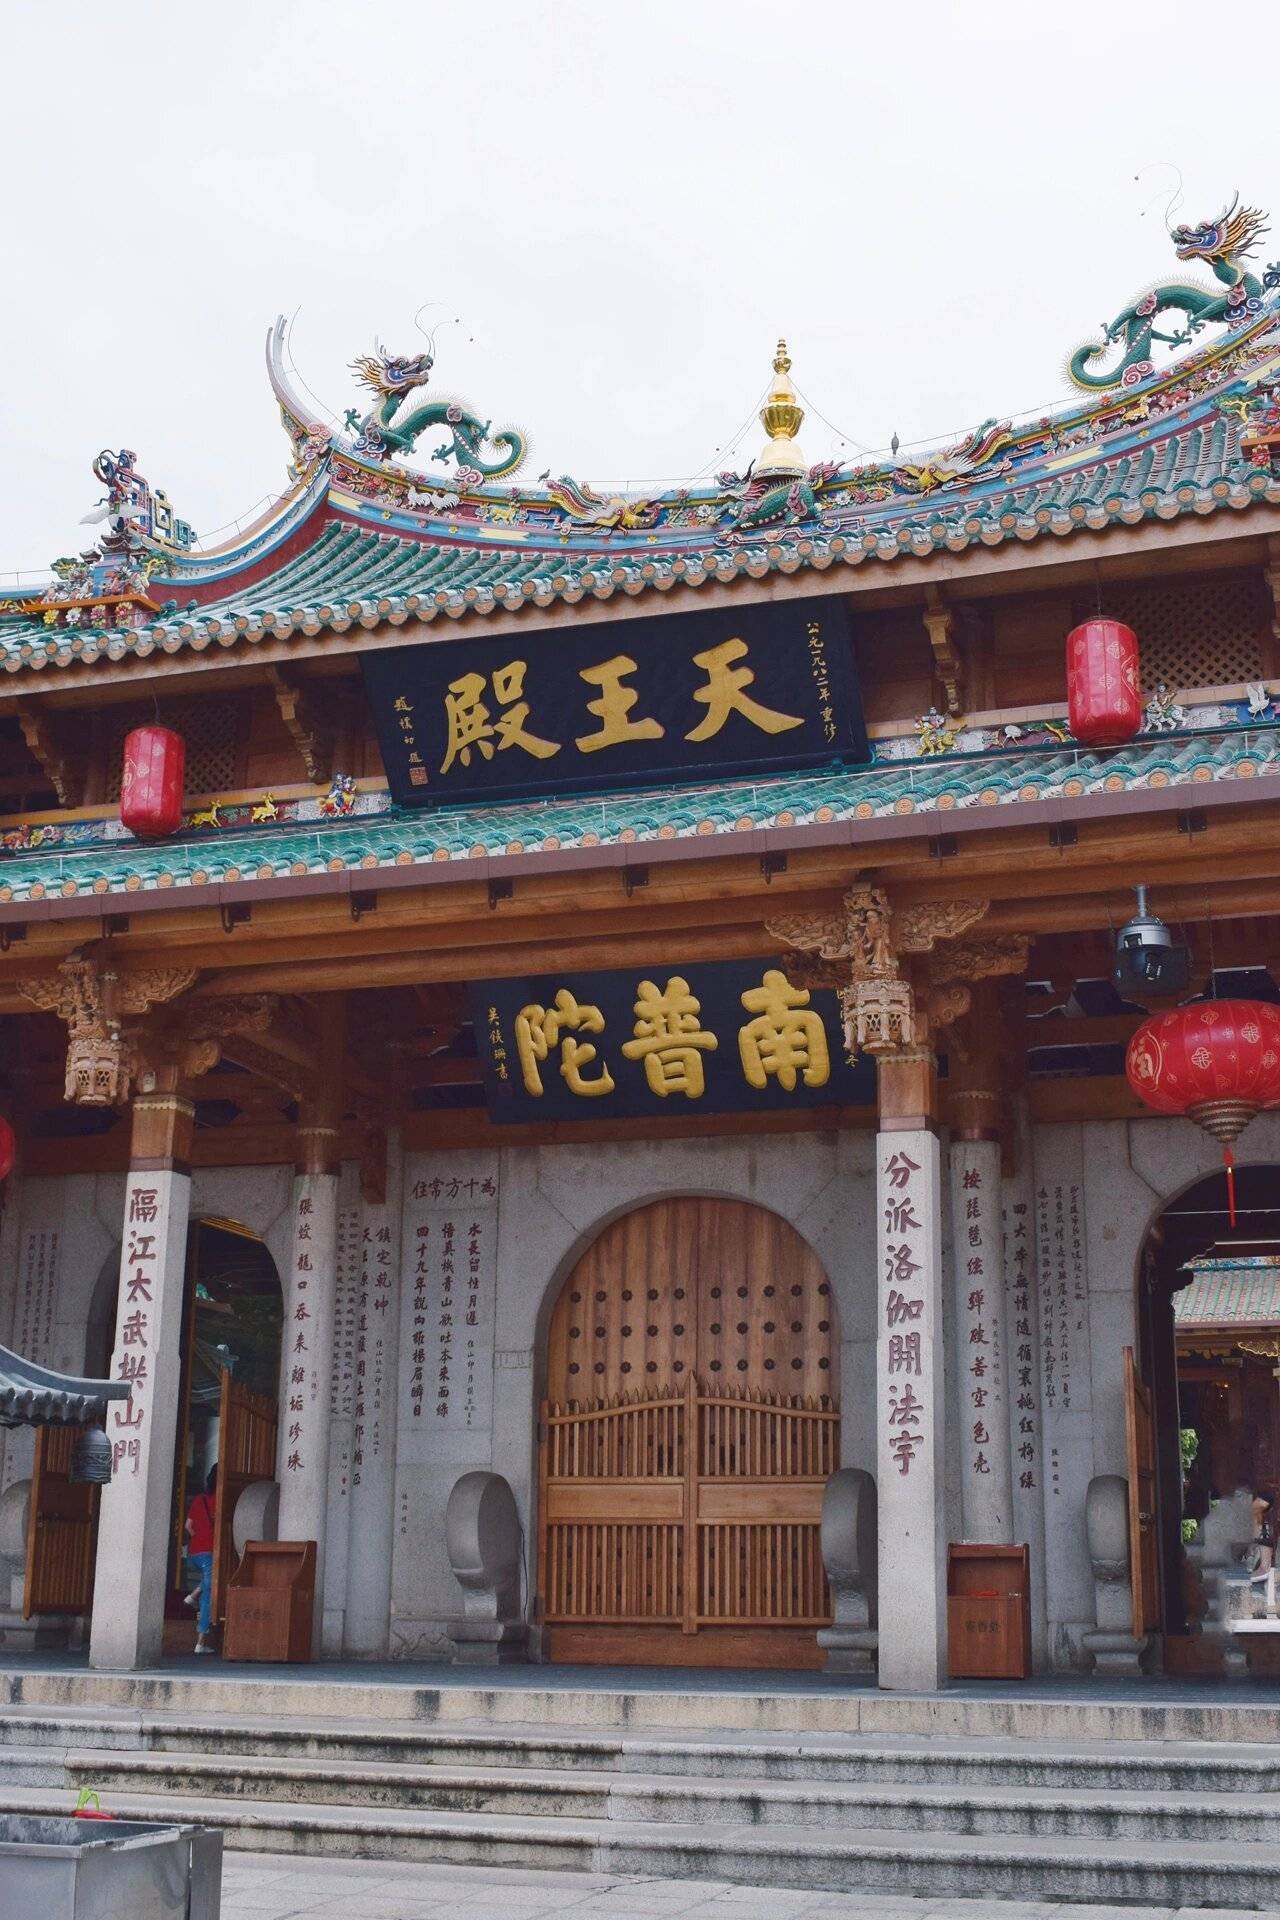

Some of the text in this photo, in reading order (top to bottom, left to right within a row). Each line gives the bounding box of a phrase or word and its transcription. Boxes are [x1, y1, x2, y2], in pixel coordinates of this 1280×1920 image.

[112, 1188, 159, 1477] 隔江太武拱山門
[884, 1151, 925, 1476] 分派洛伽開法宇
